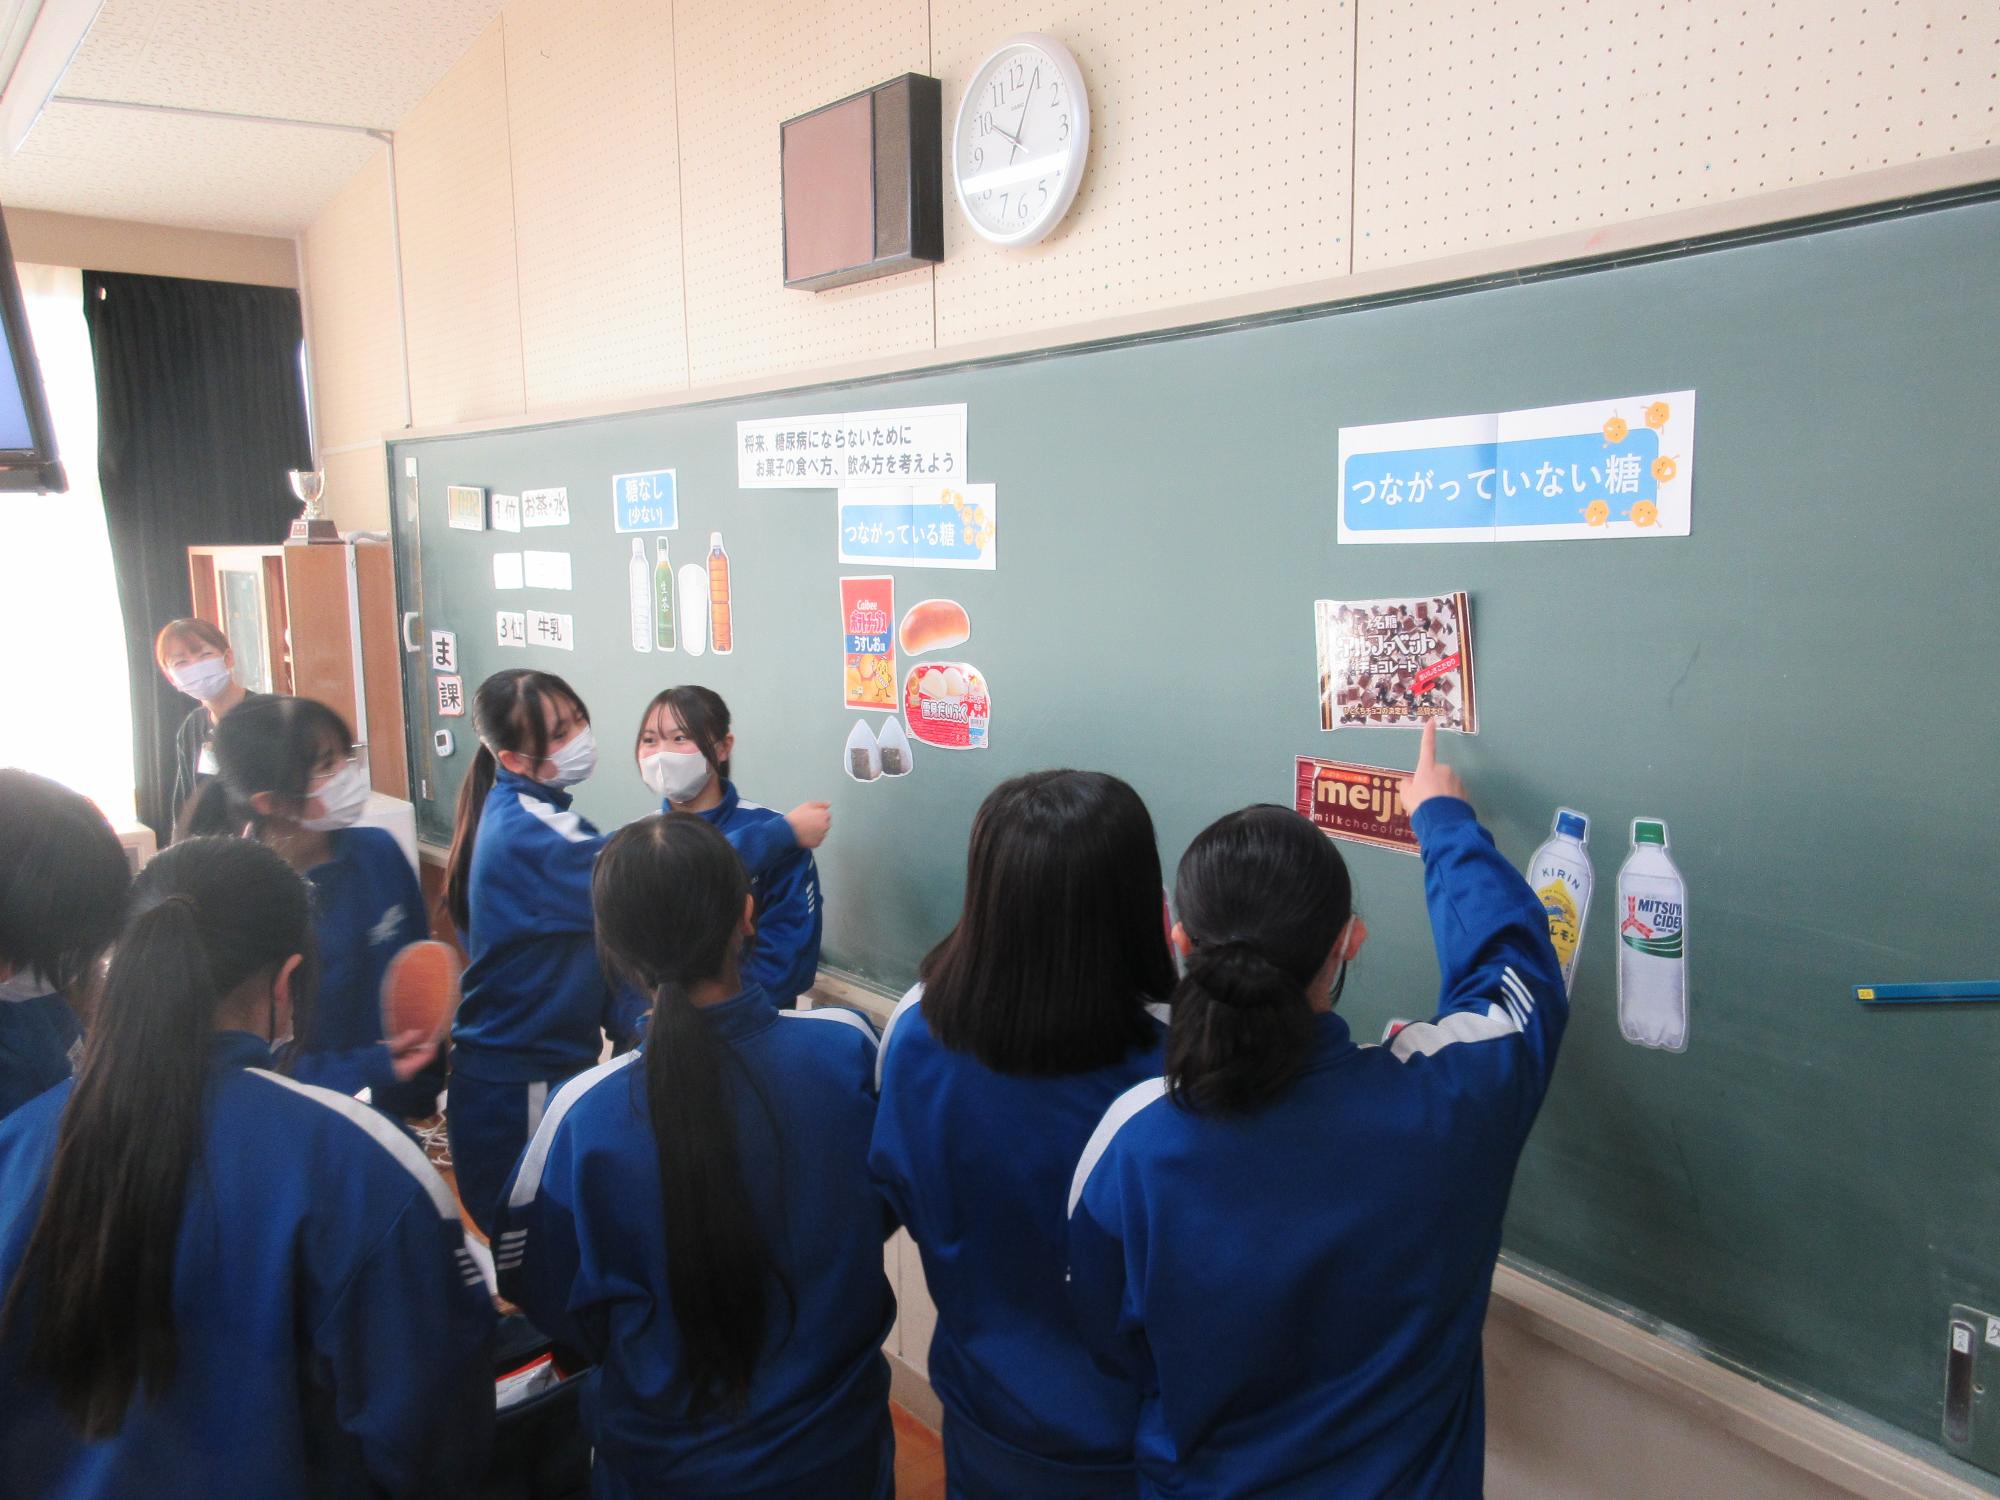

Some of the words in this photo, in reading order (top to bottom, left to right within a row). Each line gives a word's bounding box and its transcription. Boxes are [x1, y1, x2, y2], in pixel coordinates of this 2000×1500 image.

[1009, 64, 1024, 91] 12
[992, 82, 1006, 107] 11
[1050, 82, 1060, 108] 2
[978, 112, 993, 136] 10
[1059, 114, 1069, 141] 3
[974, 147, 984, 172] 9
[1000, 192, 1008, 218] 7
[1038, 179, 1048, 207] 5
[1018, 193, 1028, 219] 6
[744, 425, 912, 454] 将来、糖尿病にならないために
[755, 452, 955, 477] お菓子の食べ方、飲み方を考えよう
[625, 478, 664, 505] 糖なし
[1351, 452, 1642, 506] つながっていない糖
[844, 521, 956, 547] つながっている糖
[856, 600, 878, 611] Calbee
[499, 618, 524, 641] 3位
[537, 617, 563, 642] 牛乳
[1372, 614, 1398, 630] 名糖
[436, 637, 452, 667] ま
[1337, 632, 1436, 657] アルファベット
[1358, 659, 1418, 675] チョコレート
[439, 682, 461, 710] 課
[921, 701, 968, 723] 雪見だいふく
[1541, 867, 1581, 891] KIRIN
